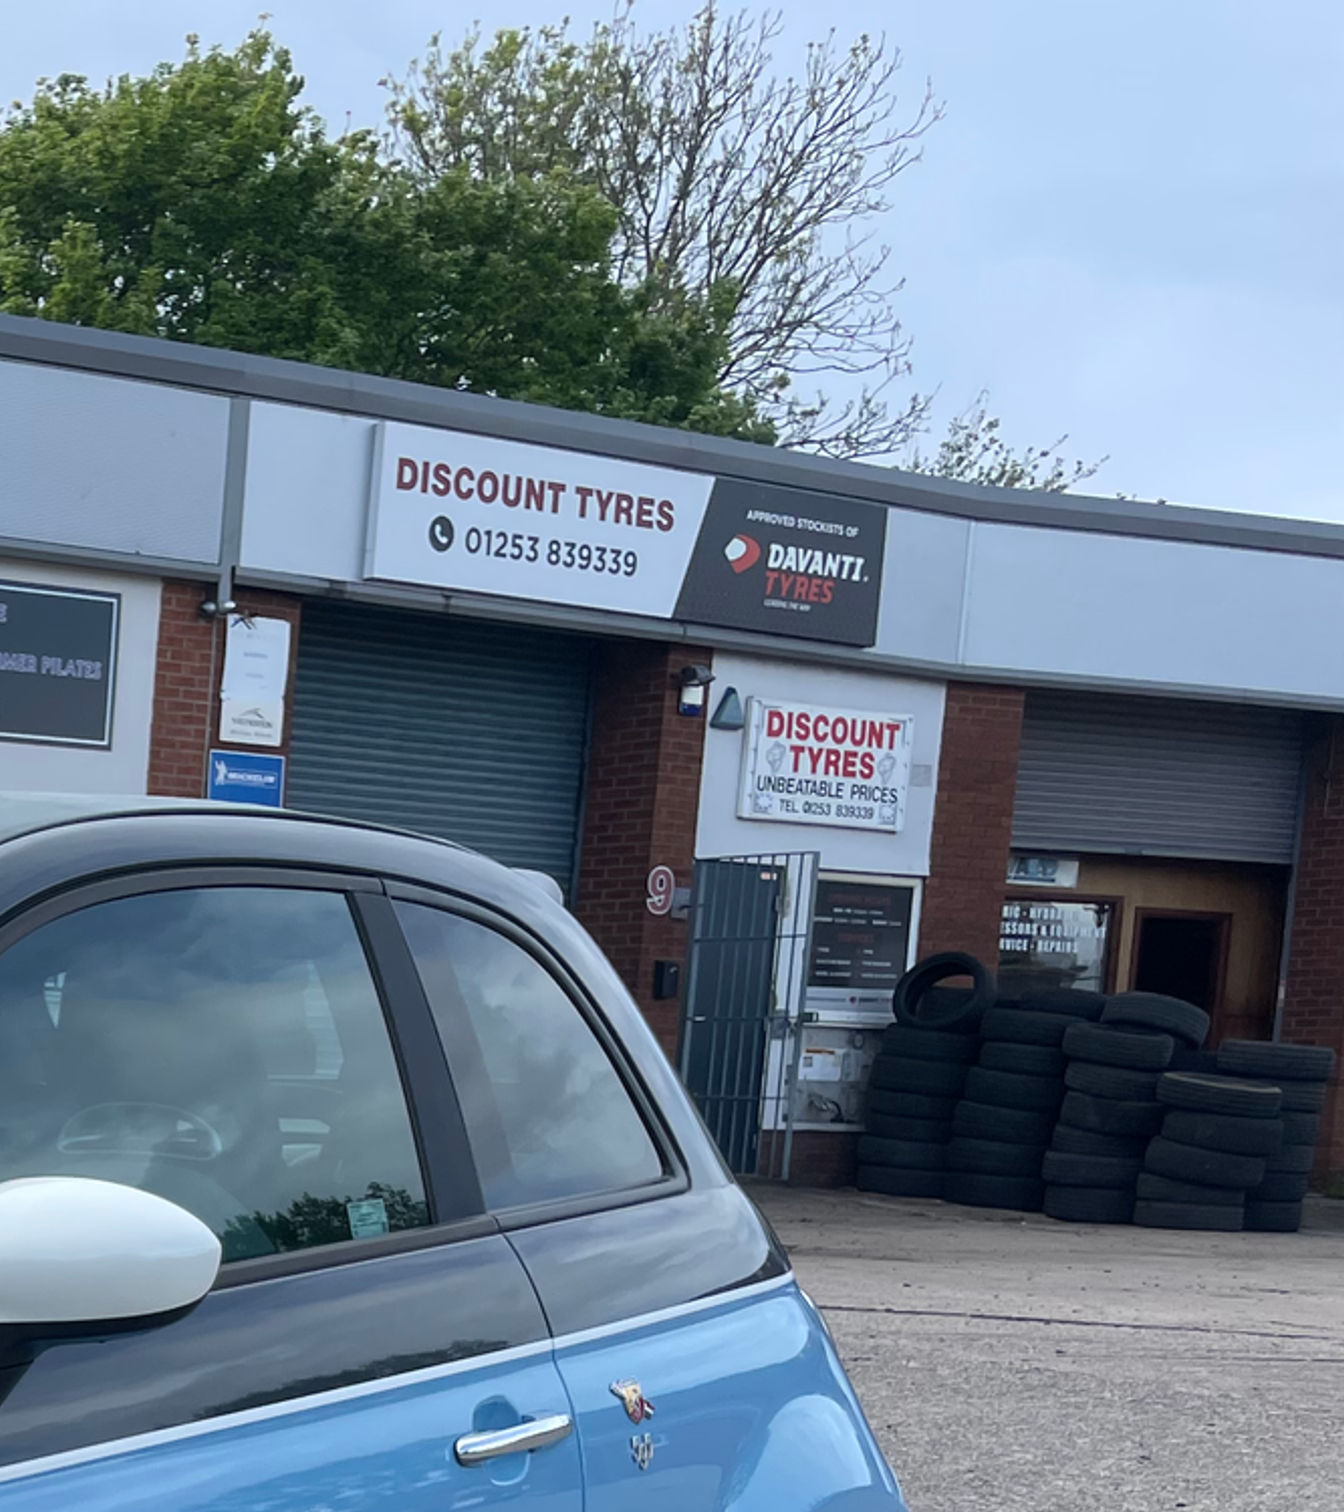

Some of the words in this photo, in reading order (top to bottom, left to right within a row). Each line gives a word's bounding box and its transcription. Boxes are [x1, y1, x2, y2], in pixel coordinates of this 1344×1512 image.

[396, 457, 566, 514] DISCOUNT
[575, 486, 675, 532] TYRES
[746, 510, 795, 528] APPROVED
[797, 518, 844, 535] STOCKISTS
[846, 526, 859, 538] OF
[465, 527, 540, 562] 01253
[547, 539, 638, 577] 839339
[765, 570, 835, 604] TYRES
[41, 655, 102, 680] PILATES
[766, 709, 900, 750] DISCOUNT
[789, 745, 875, 780] TYRES
[756, 775, 844, 799] UNBEATABLE
[850, 784, 898, 804] PRICES
[802, 800, 831, 816] 01253
[835, 804, 875, 819] 839339
[646, 865, 675, 915] 9
